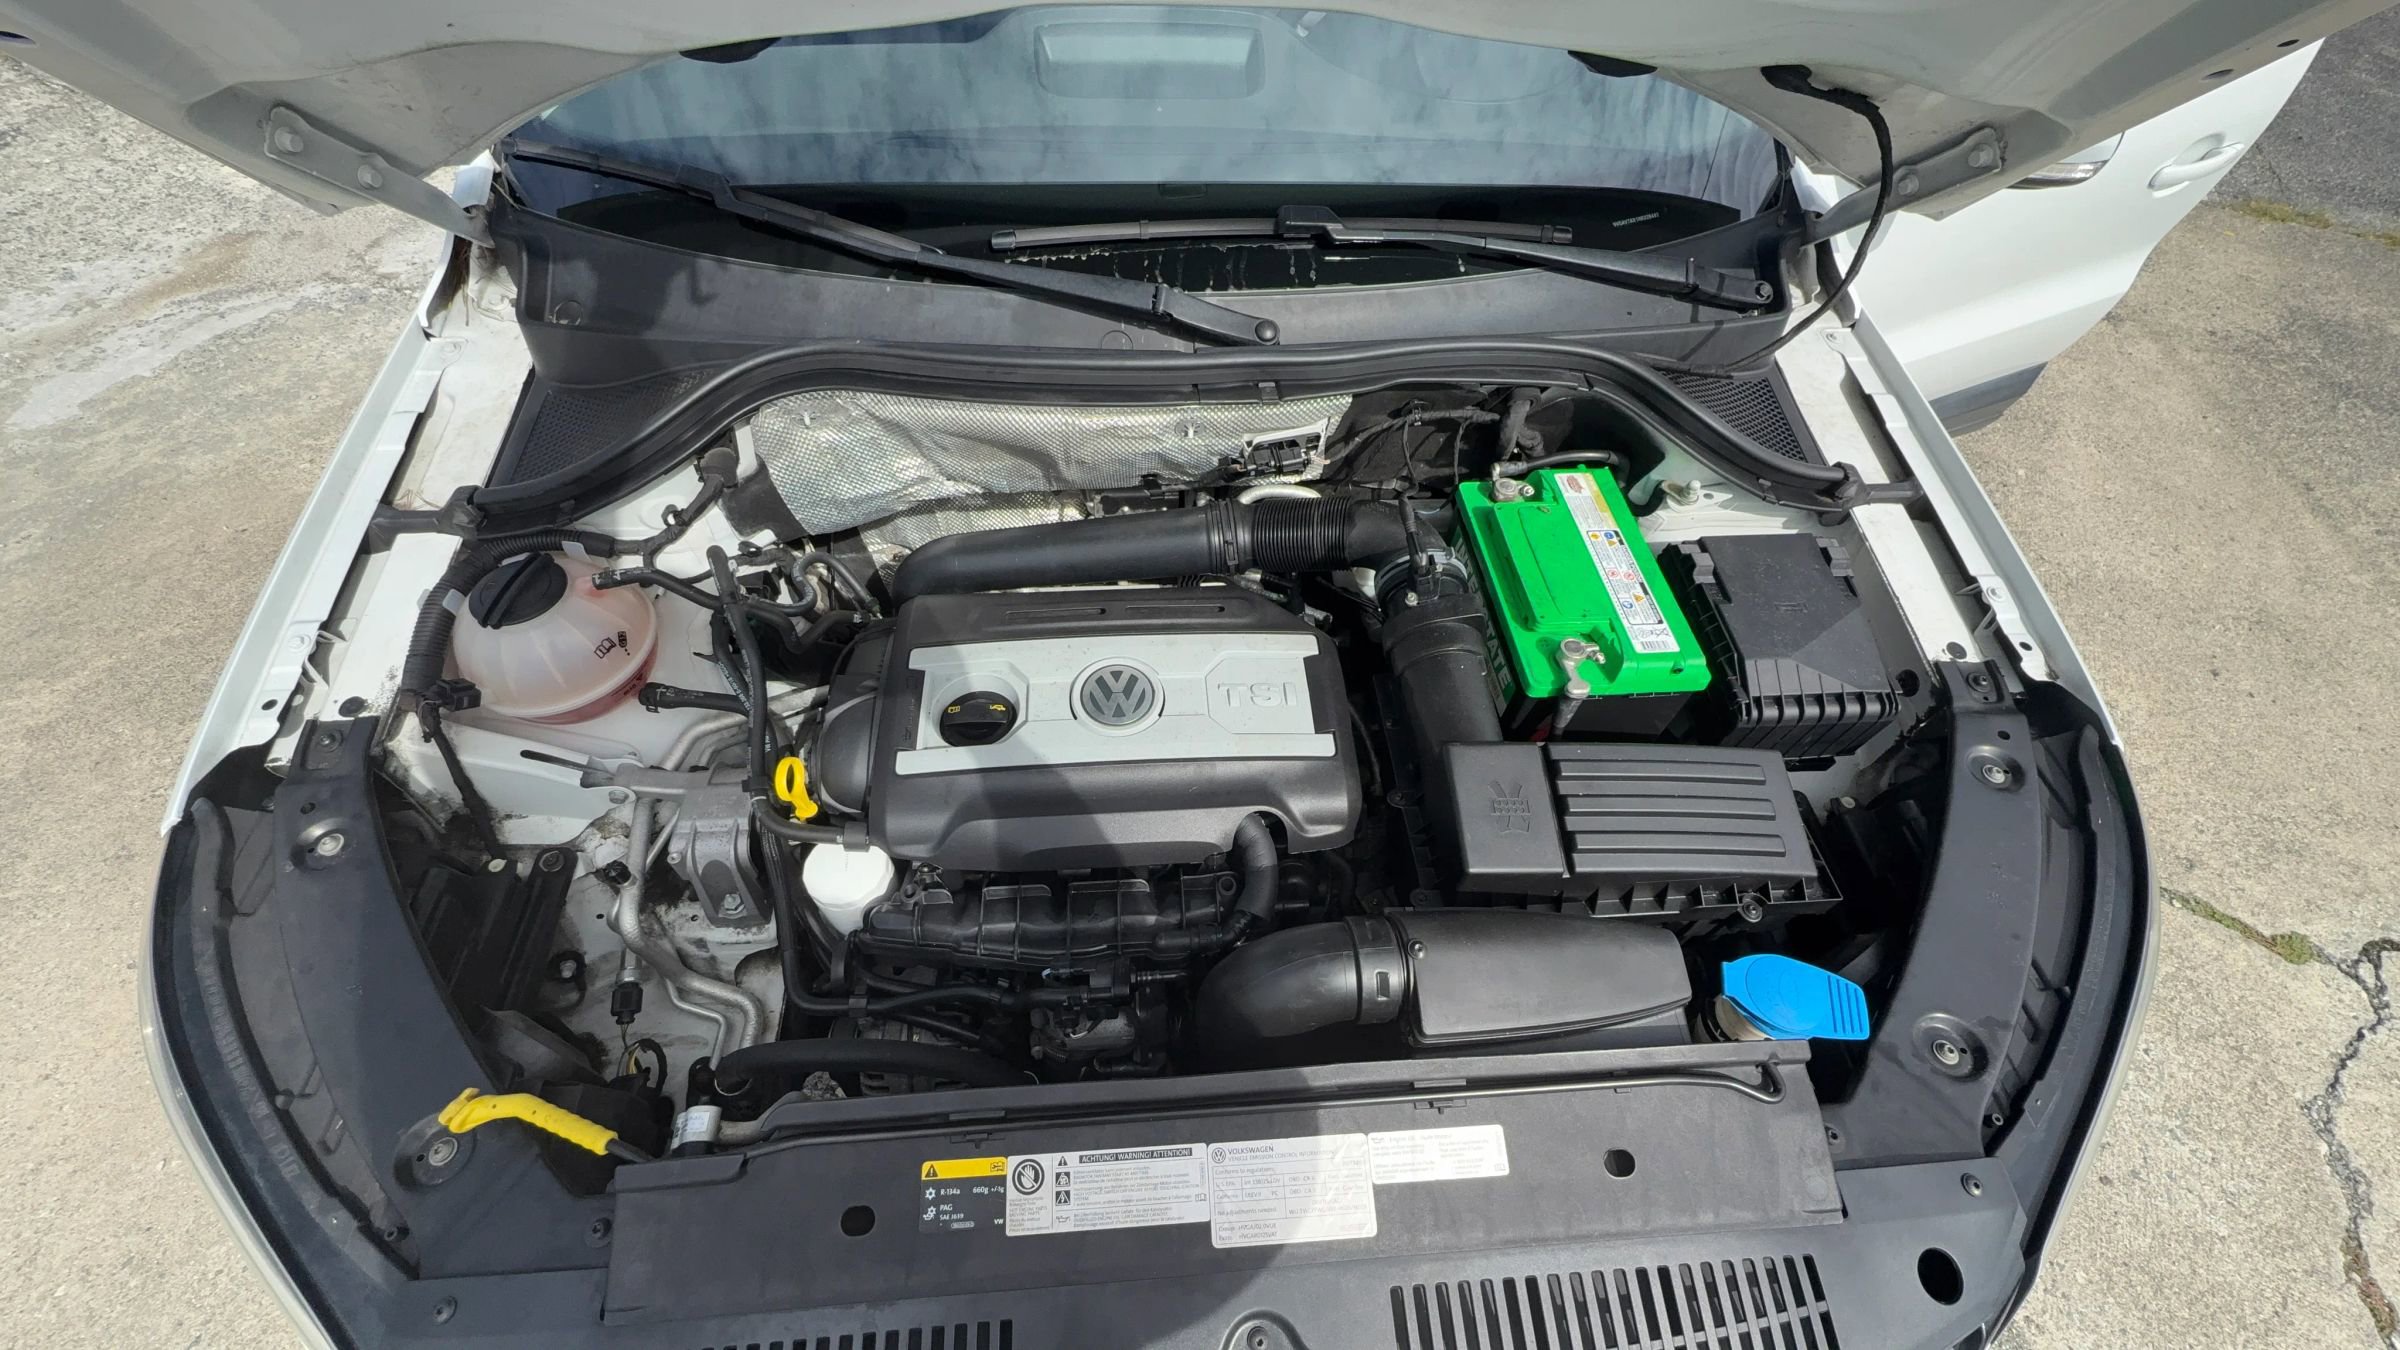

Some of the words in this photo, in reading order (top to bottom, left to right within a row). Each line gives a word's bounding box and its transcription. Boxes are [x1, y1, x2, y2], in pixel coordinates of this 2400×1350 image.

[1216, 681, 1299, 709] TSI
[1228, 1145, 1274, 1155] VOLKSWAGEN
[1081, 1154, 1116, 1163] ACHTUNG!
[1117, 1151, 1151, 1160] WARNING!
[1153, 1148, 1191, 1158] ATTENTION!
[972, 1186, 989, 1195] 660g
[940, 1203, 953, 1211] PAG
[939, 1213, 950, 1221] SAE
